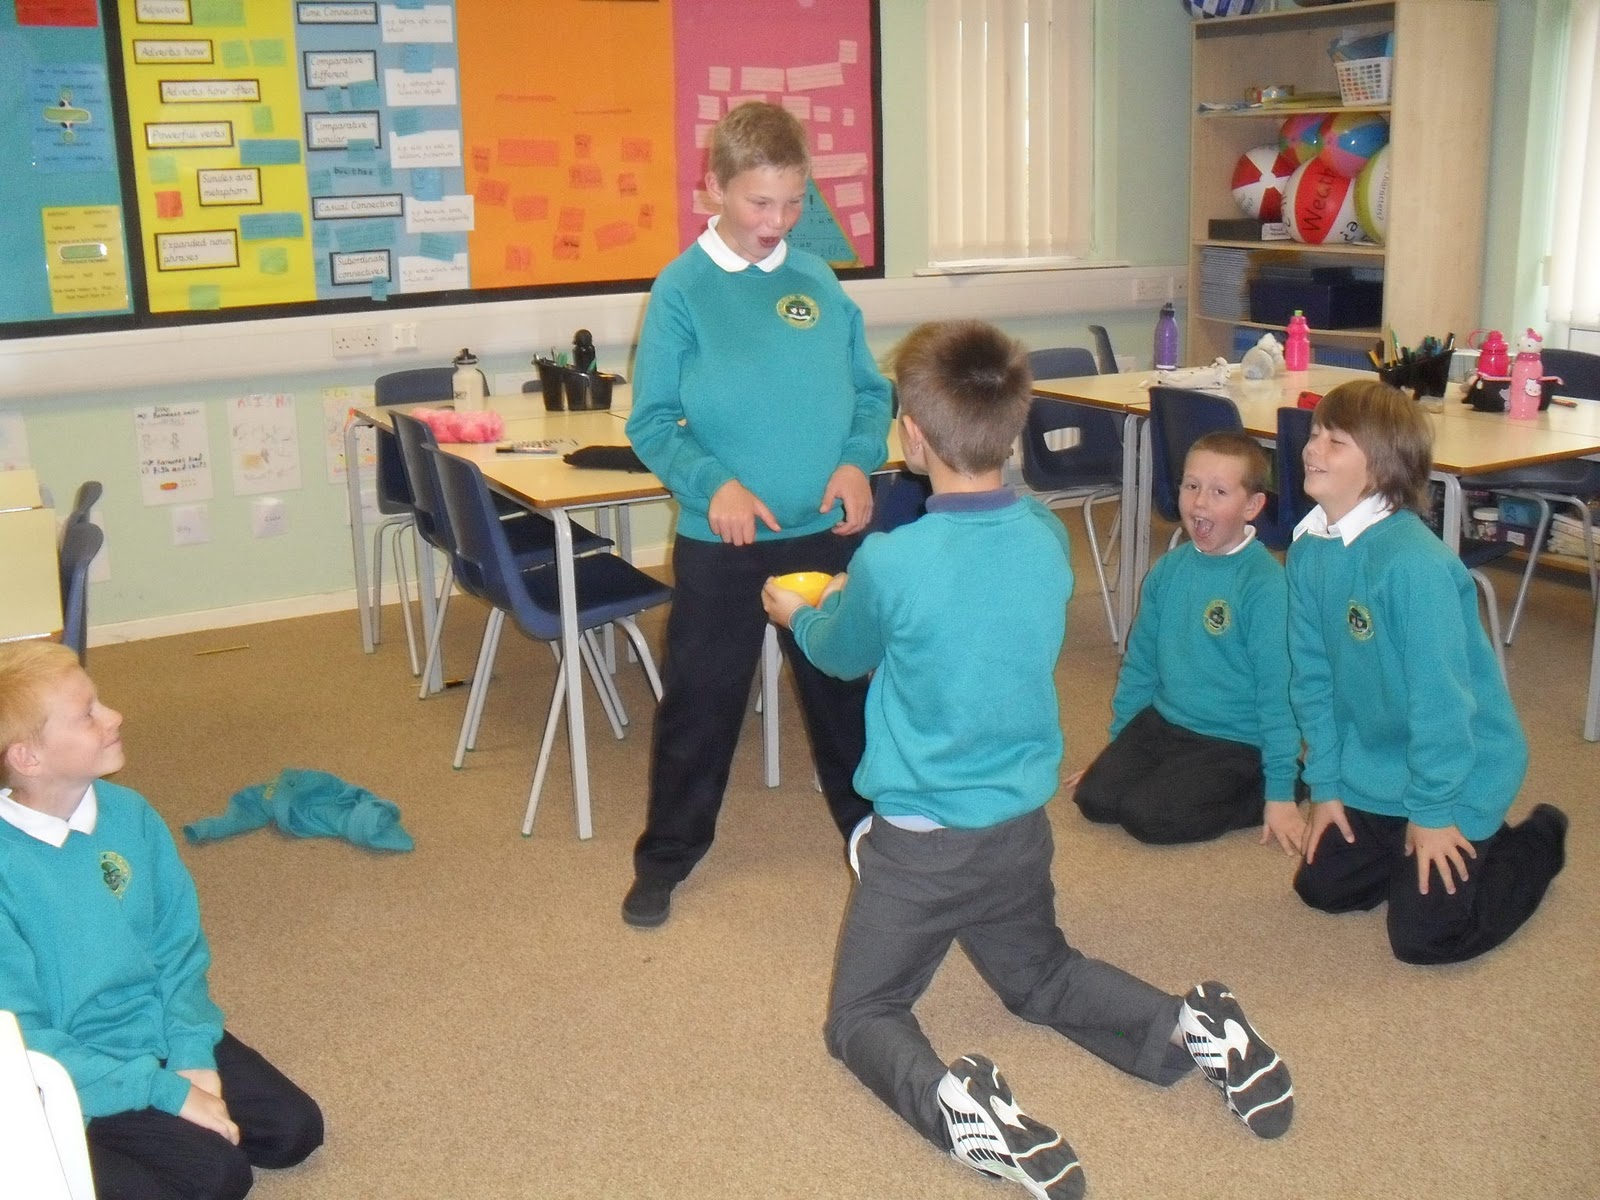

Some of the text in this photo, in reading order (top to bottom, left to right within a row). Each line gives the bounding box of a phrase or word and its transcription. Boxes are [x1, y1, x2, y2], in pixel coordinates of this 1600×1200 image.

[184, 47, 205, 56] how
[311, 56, 364, 67] Comparative
[313, 70, 349, 82] different
[165, 86, 203, 96] Adverbs
[315, 121, 368, 132] Comparative
[152, 127, 197, 142] Powerful
[236, 173, 253, 183] and
[351, 200, 399, 211] Connectives
[162, 238, 207, 252] Expanded
[164, 253, 199, 267] phrases
